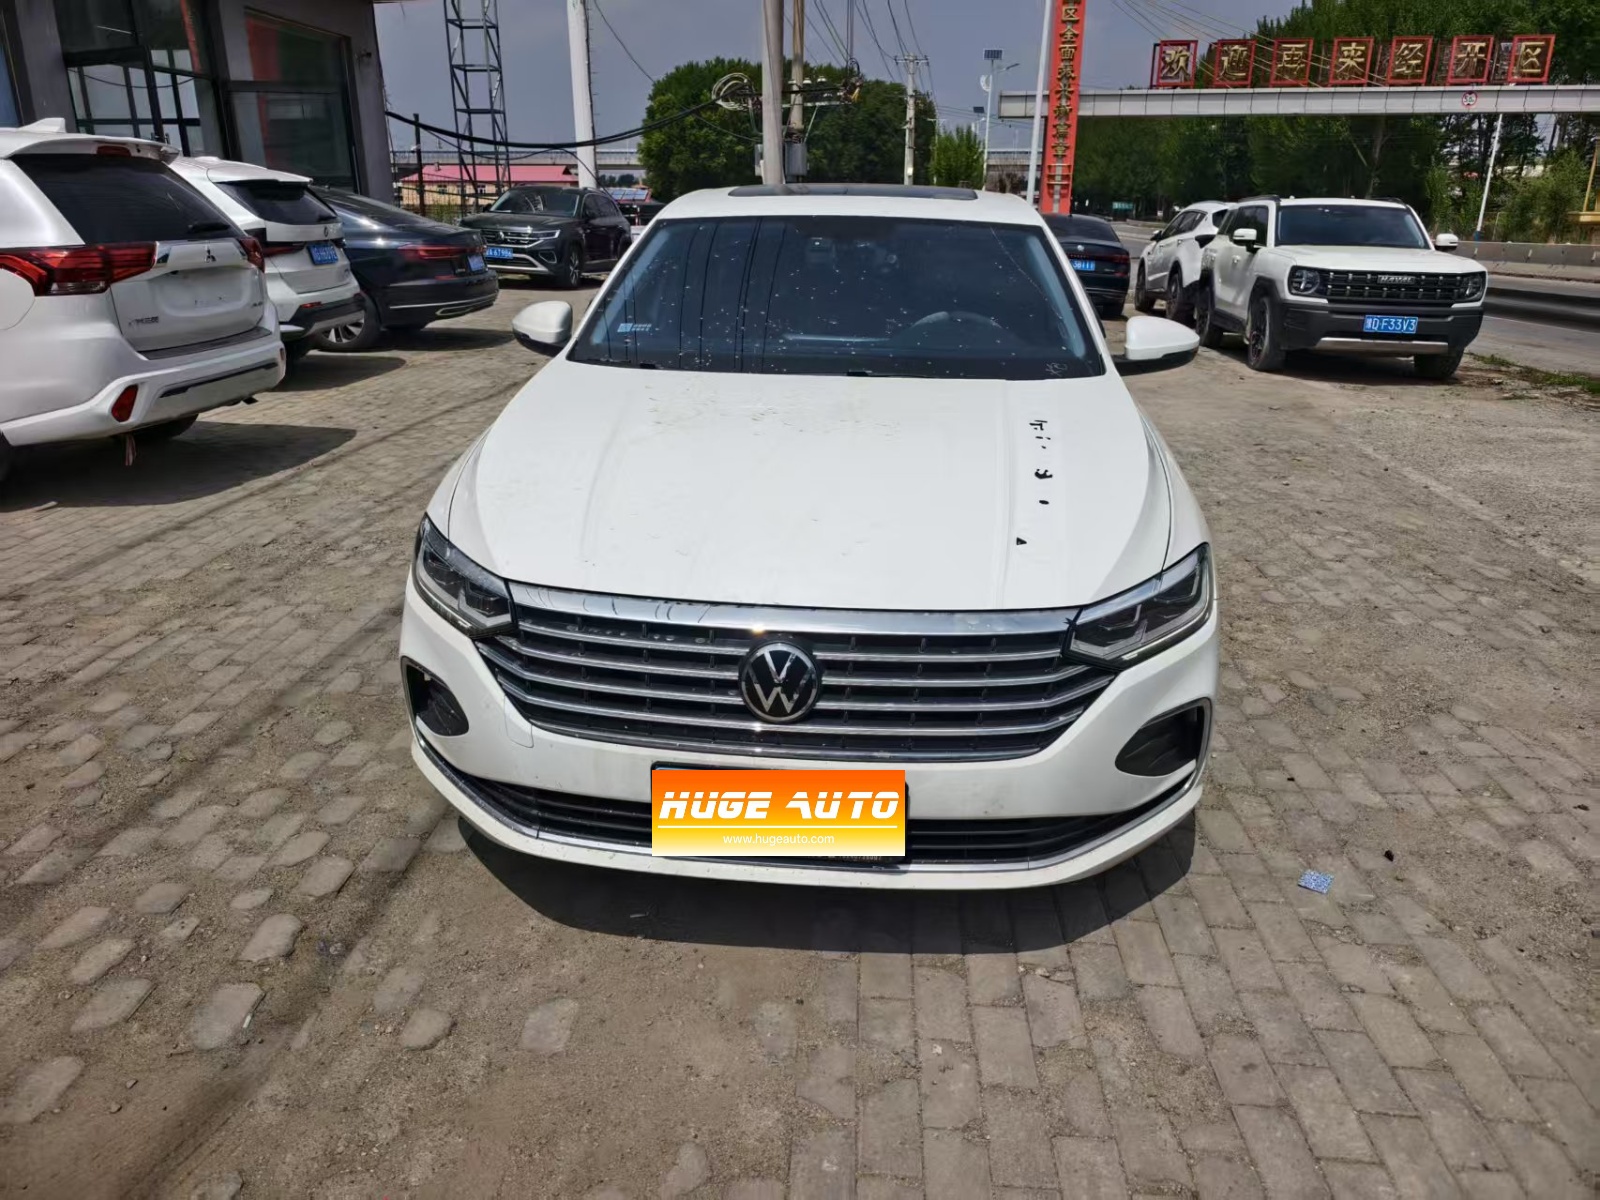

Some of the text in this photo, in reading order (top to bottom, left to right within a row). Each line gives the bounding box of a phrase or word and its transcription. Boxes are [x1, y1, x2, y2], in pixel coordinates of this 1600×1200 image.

[1052, 0, 1080, 157] 区全面振兴新篇章
[1161, 42, 1545, 78] 欢迎再来经开区
